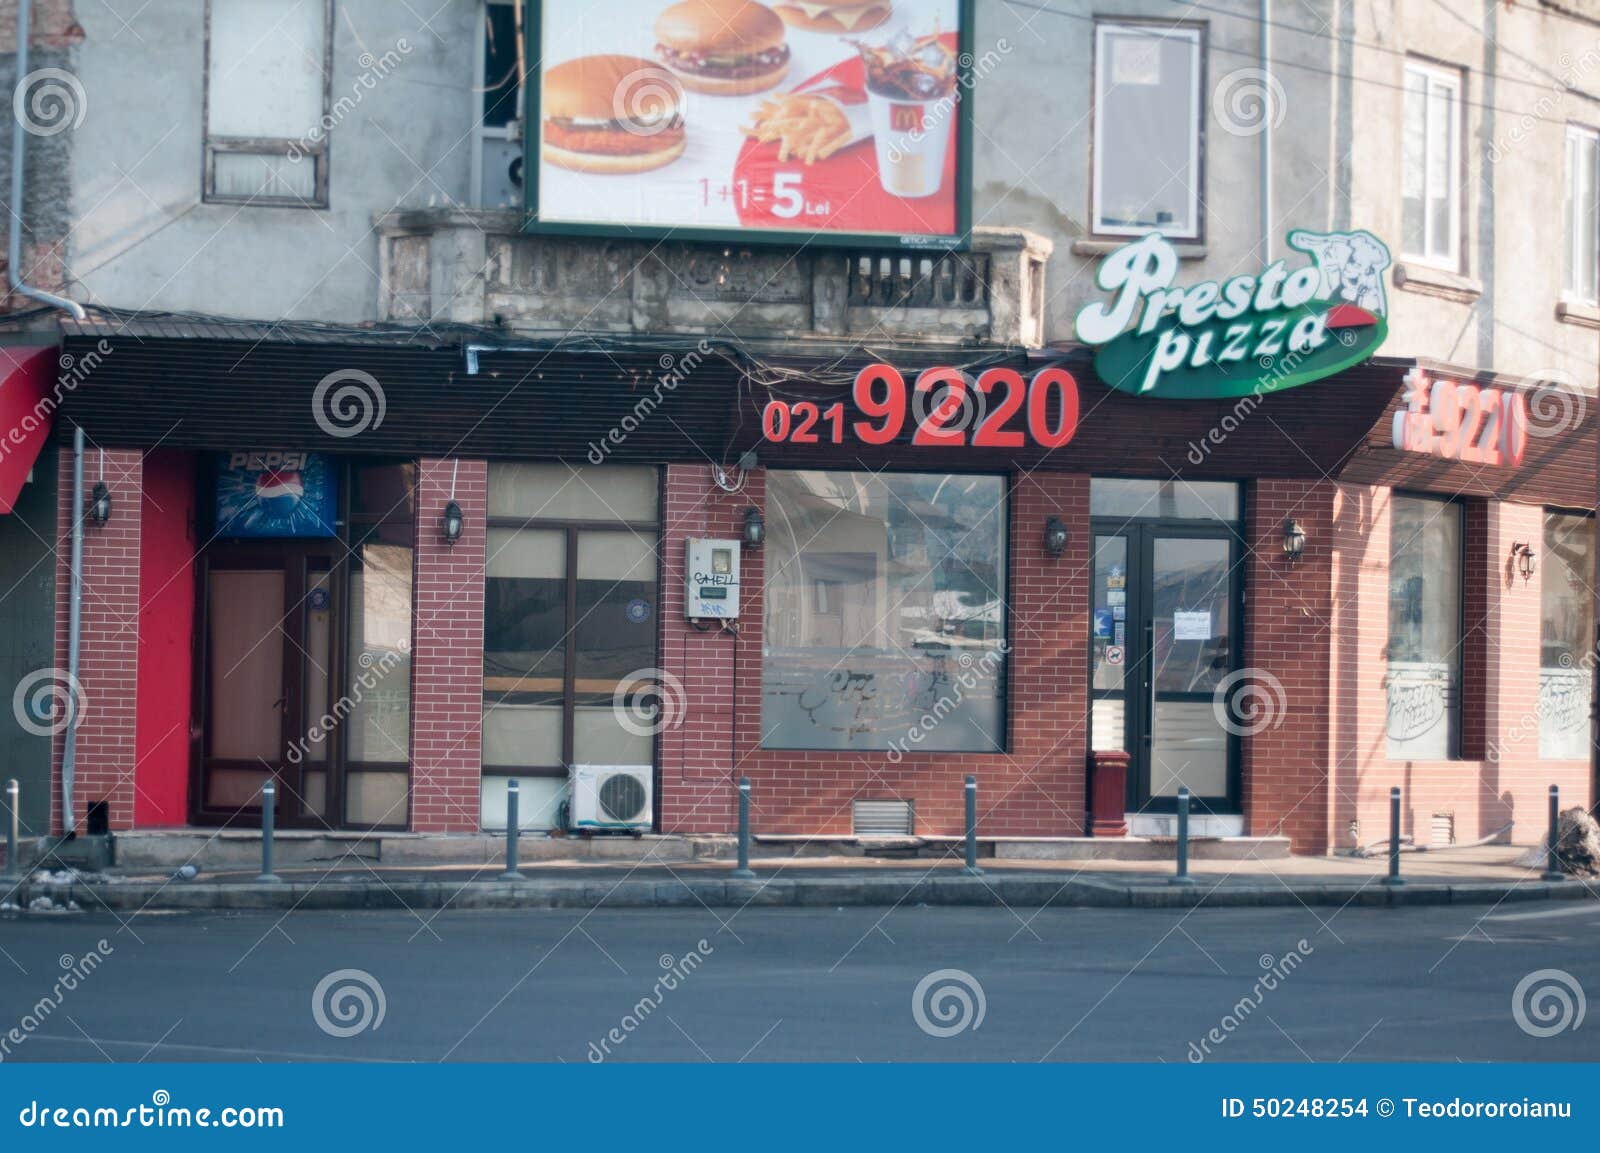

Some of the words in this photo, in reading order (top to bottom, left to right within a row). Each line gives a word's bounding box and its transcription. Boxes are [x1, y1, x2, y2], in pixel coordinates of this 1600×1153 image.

[805, 201, 830, 215] Lei
[1075, 231, 1321, 344] Presto
[1139, 312, 1328, 394] pizza
[762, 400, 844, 444] 021
[853, 363, 1080, 448] 9220
[229, 452, 307, 470] PEPSI
